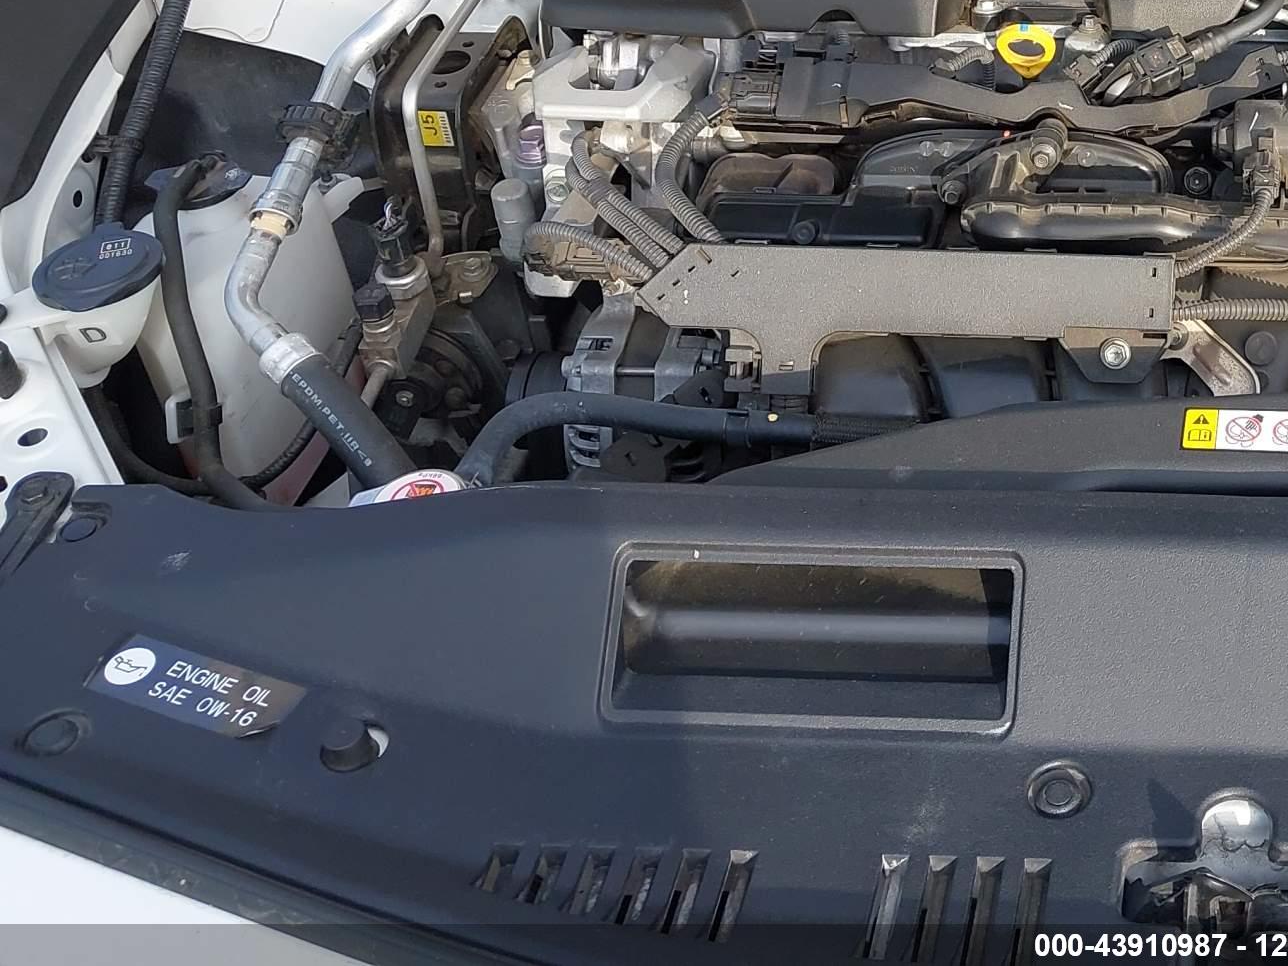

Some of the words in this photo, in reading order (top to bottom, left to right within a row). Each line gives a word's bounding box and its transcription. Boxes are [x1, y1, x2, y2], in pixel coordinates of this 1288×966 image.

[148, 681, 192, 705] SAE
[196, 697, 258, 727] 0W-16
[166, 660, 239, 694] ENGINE
[242, 685, 272, 707] OIL
